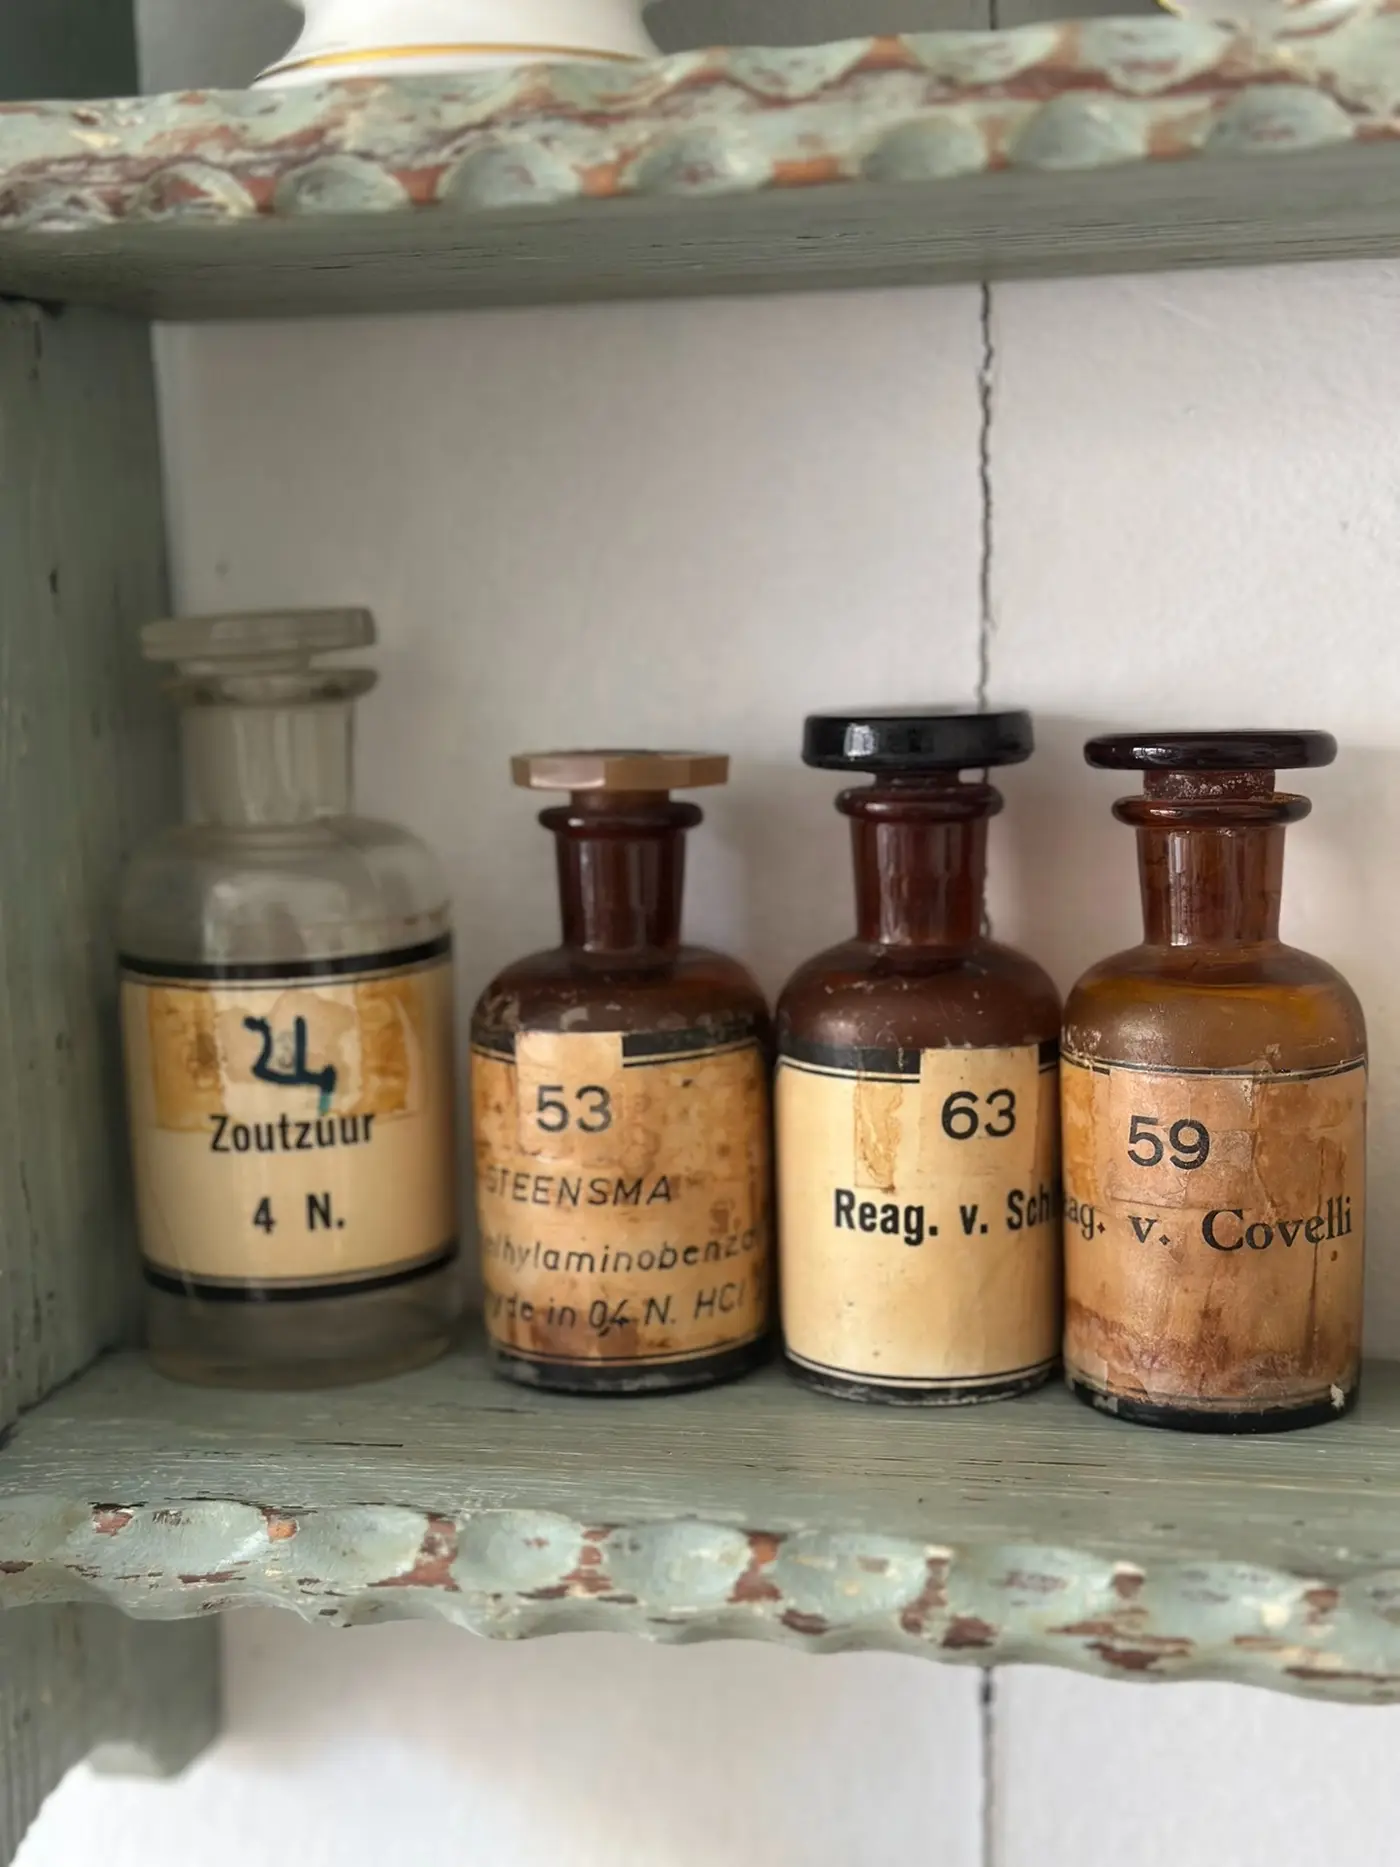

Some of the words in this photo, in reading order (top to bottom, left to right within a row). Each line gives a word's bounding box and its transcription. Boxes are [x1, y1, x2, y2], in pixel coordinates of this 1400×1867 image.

[209, 1112, 376, 1152] Zoutzuur
[536, 1084, 613, 1133] 53
[941, 1089, 1017, 1140] 63
[1127, 1114, 1210, 1170] 59
[253, 1196, 276, 1234] 4
[306, 1193, 345, 1231] N.
[834, 1187, 938, 1246] Reag.
[959, 1203, 988, 1236] v.
[1128, 1214, 1171, 1246] v.
[1202, 1195, 1352, 1252] Covelli
[549, 1297, 577, 1329] in
